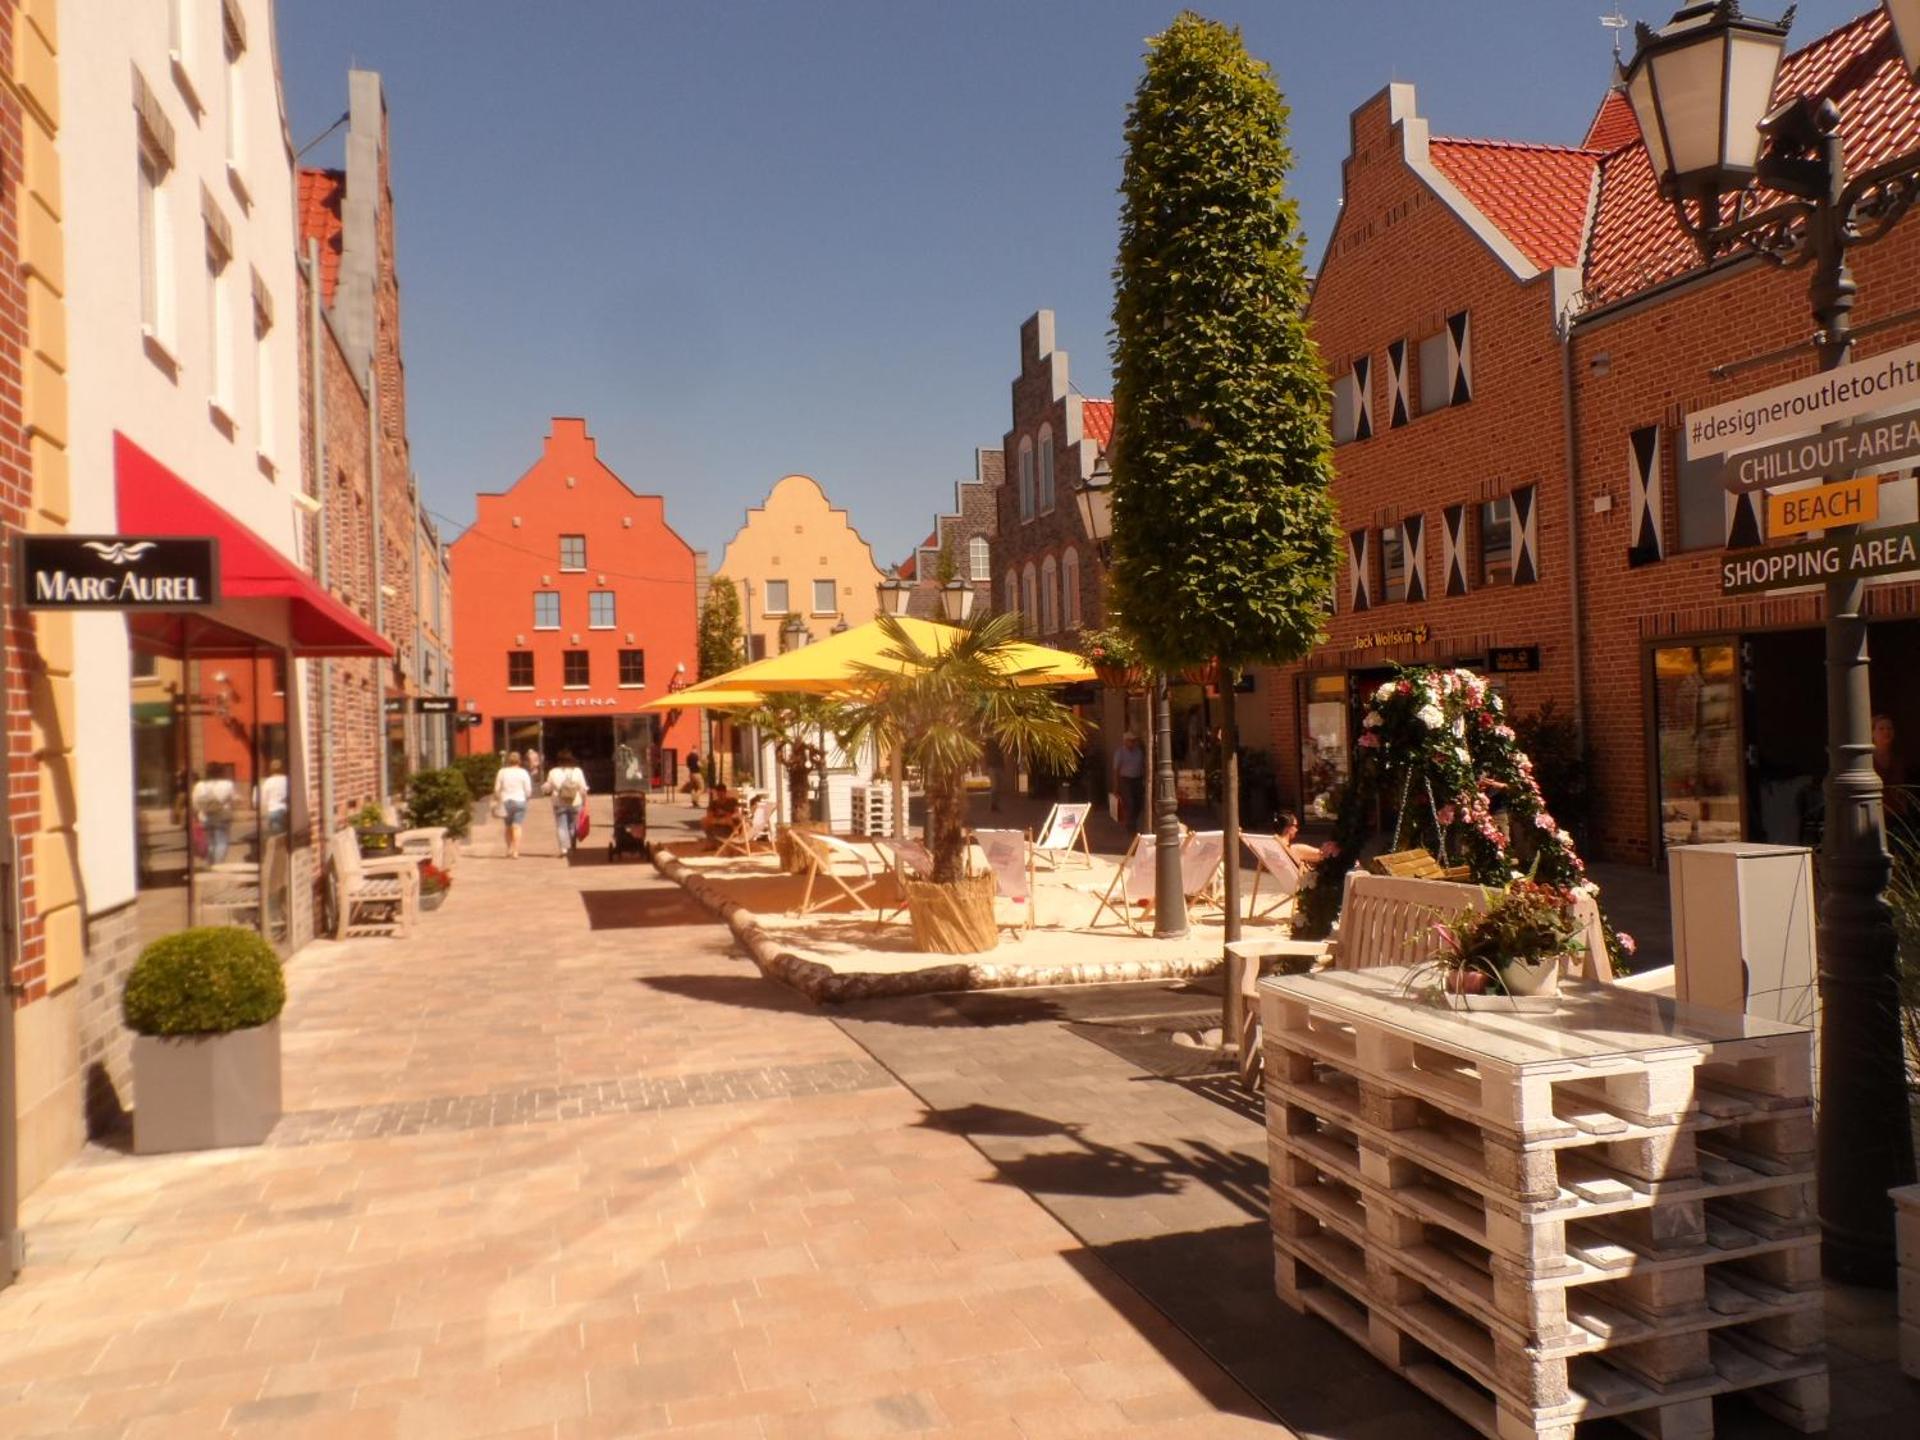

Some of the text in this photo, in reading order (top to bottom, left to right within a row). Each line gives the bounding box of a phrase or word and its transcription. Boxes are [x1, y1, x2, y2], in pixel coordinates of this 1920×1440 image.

[1739, 420, 1920, 484] CHILLOUT-AREA
[1783, 488, 1861, 526] BEACH
[1724, 535, 1916, 588] SHOPPING AREA
[36, 571, 202, 600] MARC AUREL
[1353, 630, 1413, 649] Jack Wolfskin
[534, 697, 617, 708] ETERNA
